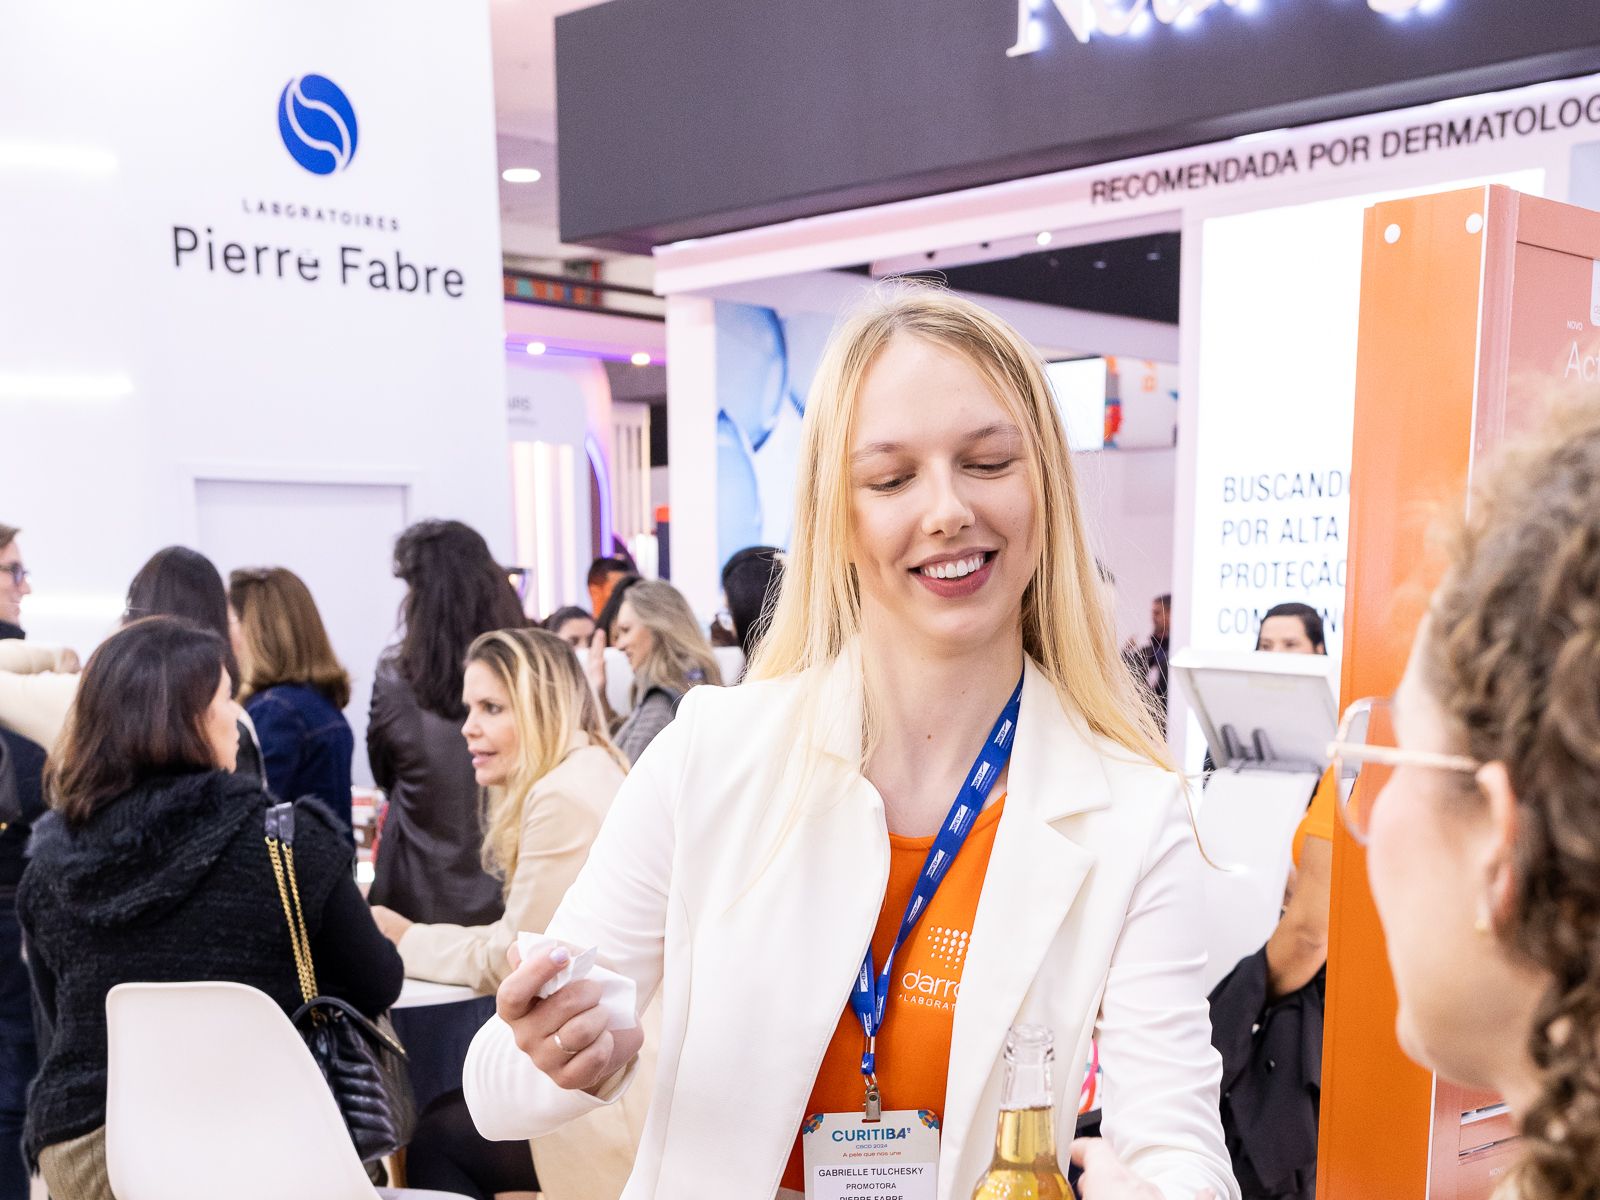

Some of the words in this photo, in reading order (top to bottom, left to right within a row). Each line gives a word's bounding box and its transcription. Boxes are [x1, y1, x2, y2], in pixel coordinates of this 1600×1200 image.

[1092, 149, 1298, 203] RECOMENDADA
[1309, 135, 1370, 170] POR
[242, 198, 400, 232] LABORATOIRES
[173, 226, 320, 281] Pierre
[340, 246, 464, 298] Fabre
[1567, 320, 1583, 331] NOVO
[1223, 470, 1350, 504] BUSCAND
[1221, 518, 1269, 547] POR
[1280, 515, 1340, 545] ALTA
[819, 1168, 869, 1178] GABRIELLE
[871, 1167, 924, 1176] TULCHESKY
[846, 1182, 897, 1190] PROMOTORA
